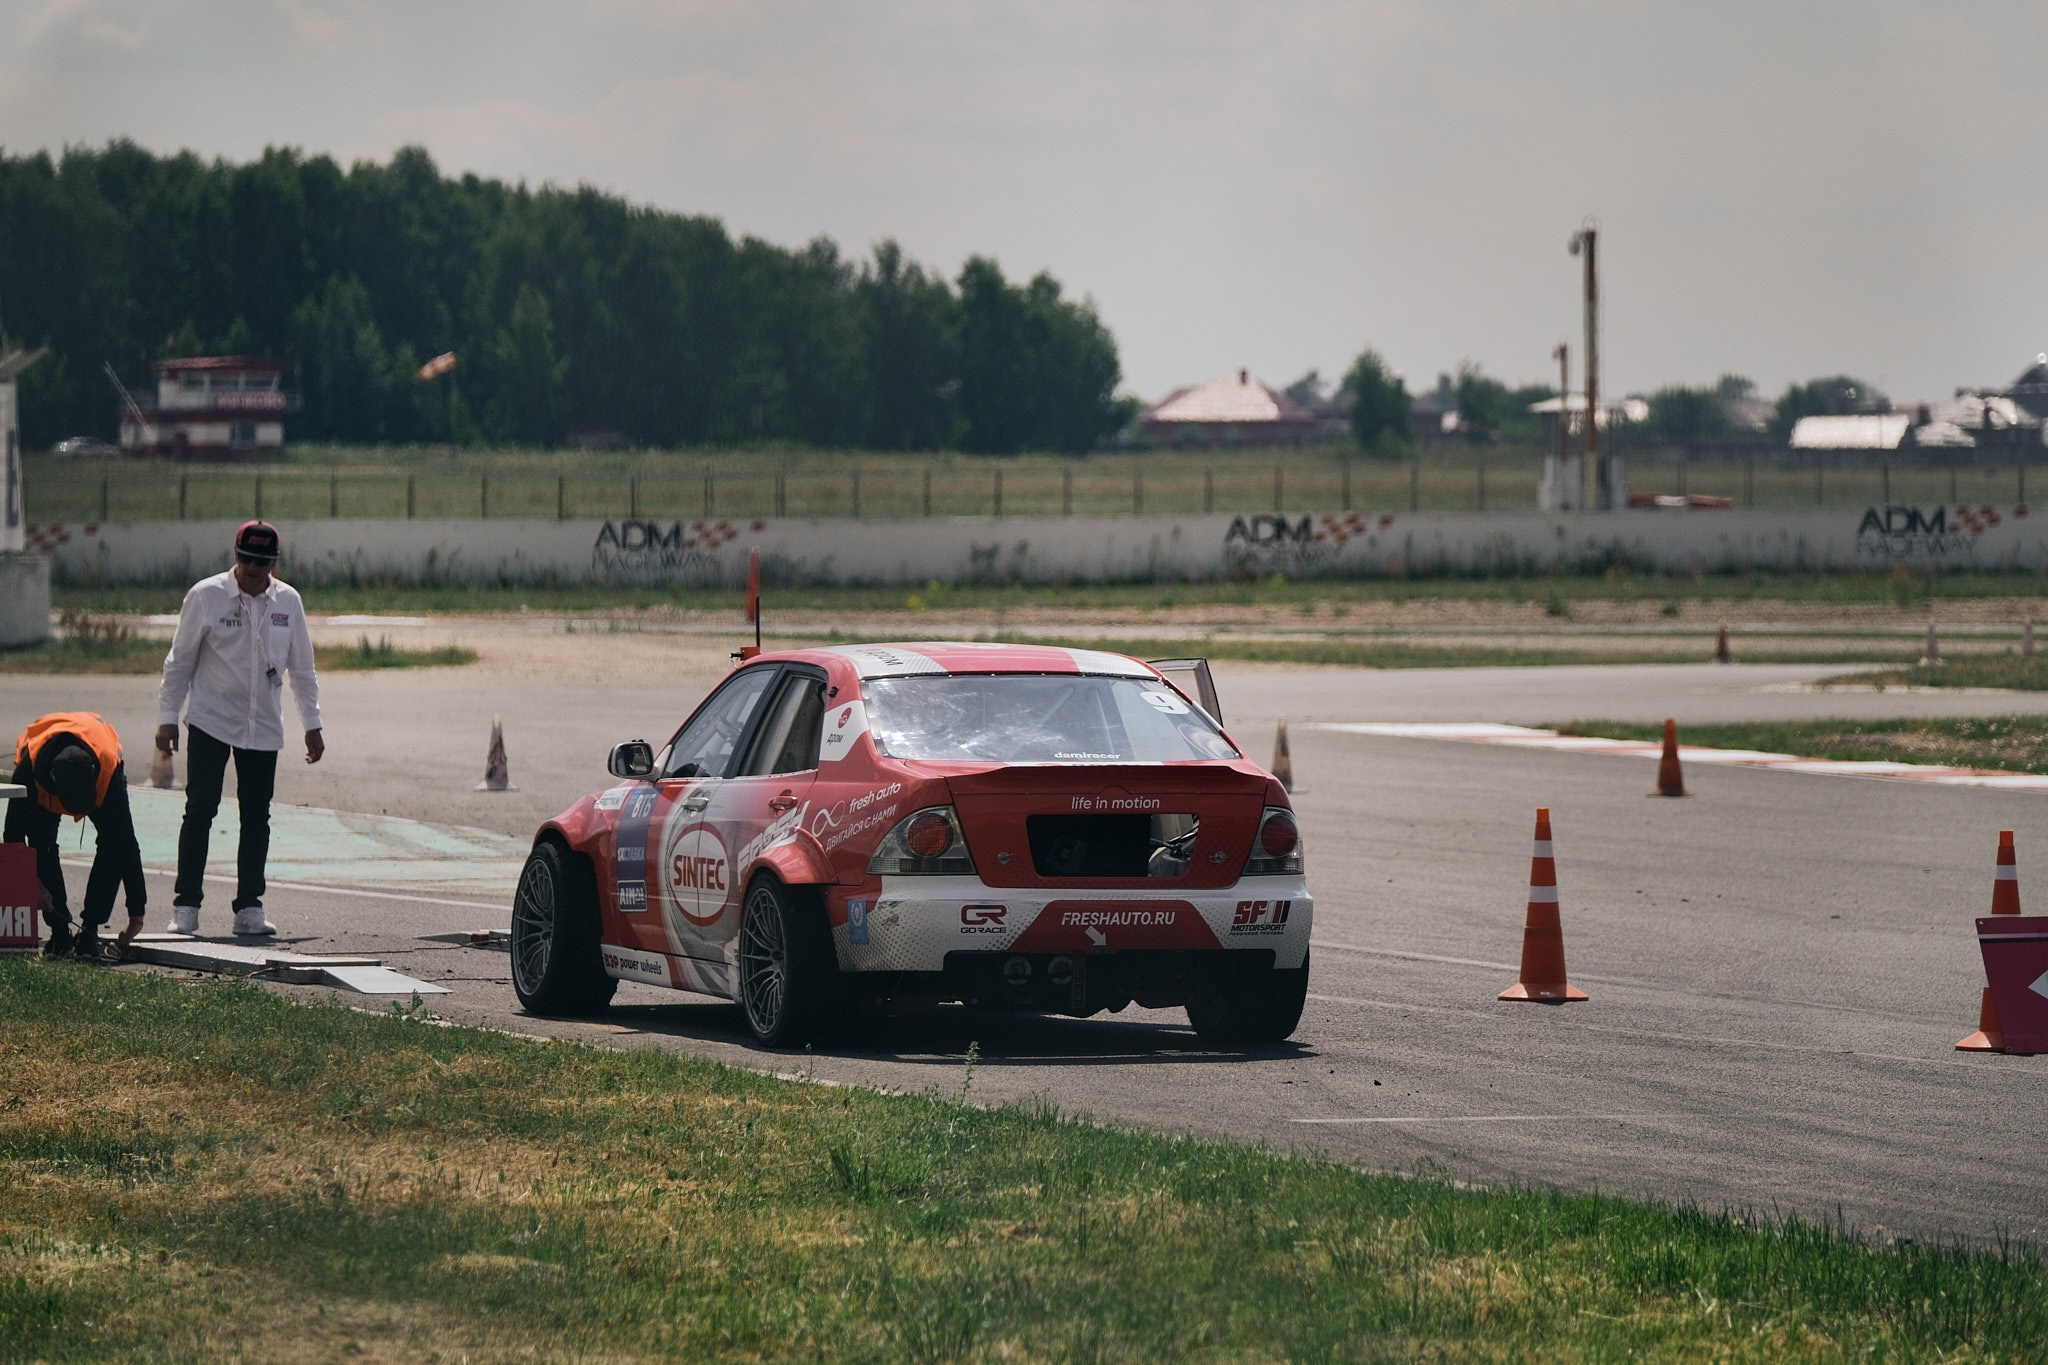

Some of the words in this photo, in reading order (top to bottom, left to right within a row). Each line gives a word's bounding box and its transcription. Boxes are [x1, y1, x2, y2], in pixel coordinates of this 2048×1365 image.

[1225, 514, 1312, 543] ADM
[1859, 505, 1945, 534] ADM
[594, 521, 682, 549] ADM
[631, 794, 656, 818] ВТБ
[849, 791, 875, 814] fresh
[876, 782, 902, 801] auto
[1071, 796, 1093, 809] life
[1096, 796, 1108, 809] in
[1111, 796, 1160, 809] motion
[826, 820, 863, 853] ДВИГАЙСЯ
[871, 804, 897, 826] НАМИ
[673, 854, 726, 890] SINTEC
[1061, 911, 1175, 926] FRESHAUTO.RU
[1231, 924, 1286, 932] MOTORSPORT
[619, 957, 639, 972] power
[640, 958, 662, 975] wheels
